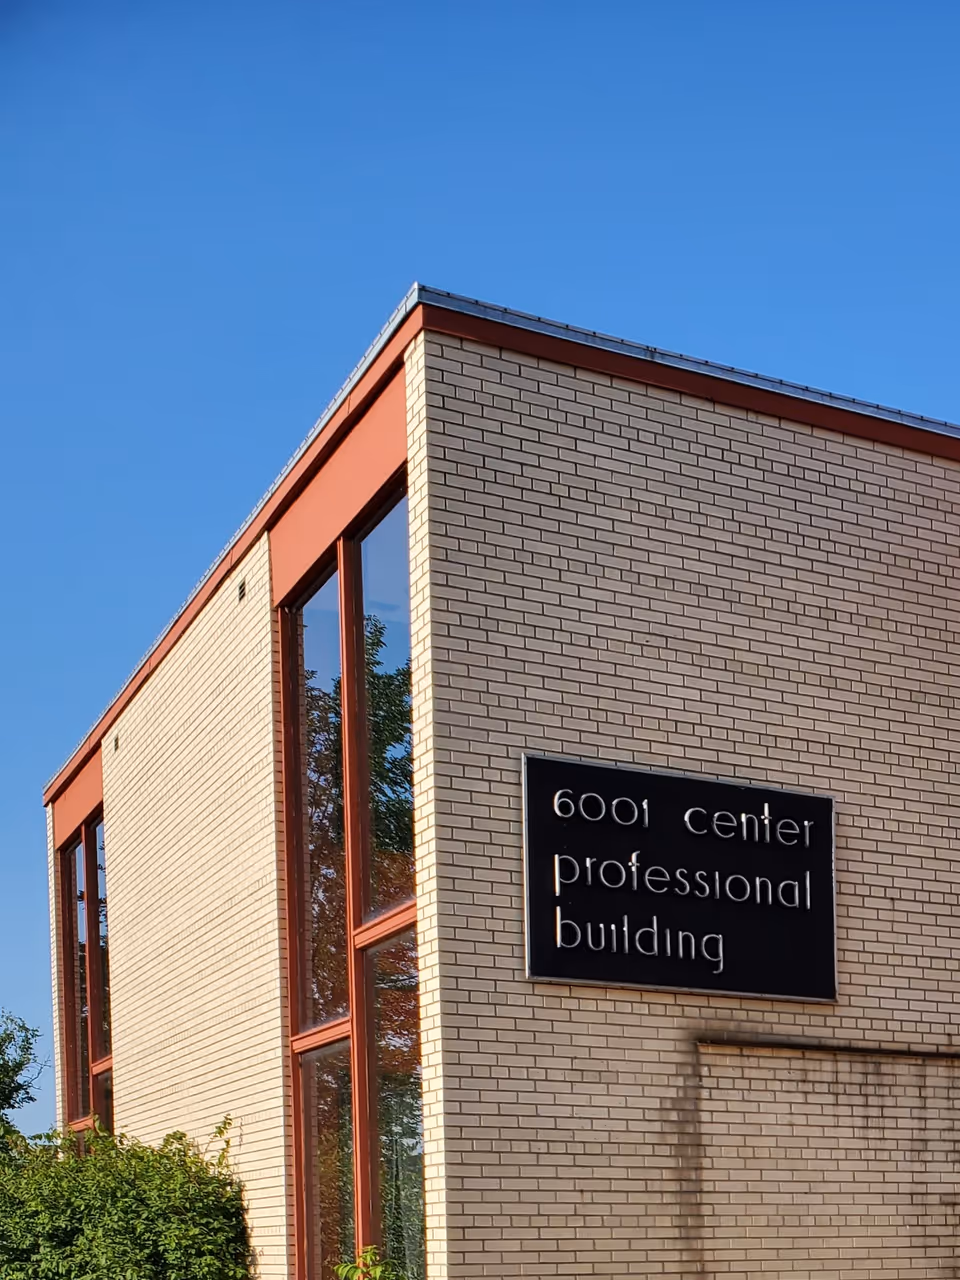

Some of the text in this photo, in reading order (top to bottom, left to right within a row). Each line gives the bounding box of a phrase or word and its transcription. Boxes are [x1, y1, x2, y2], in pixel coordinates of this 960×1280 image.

[553, 789, 814, 848] 6001 center
[554, 851, 811, 910] professional
[555, 906, 724, 974] building
